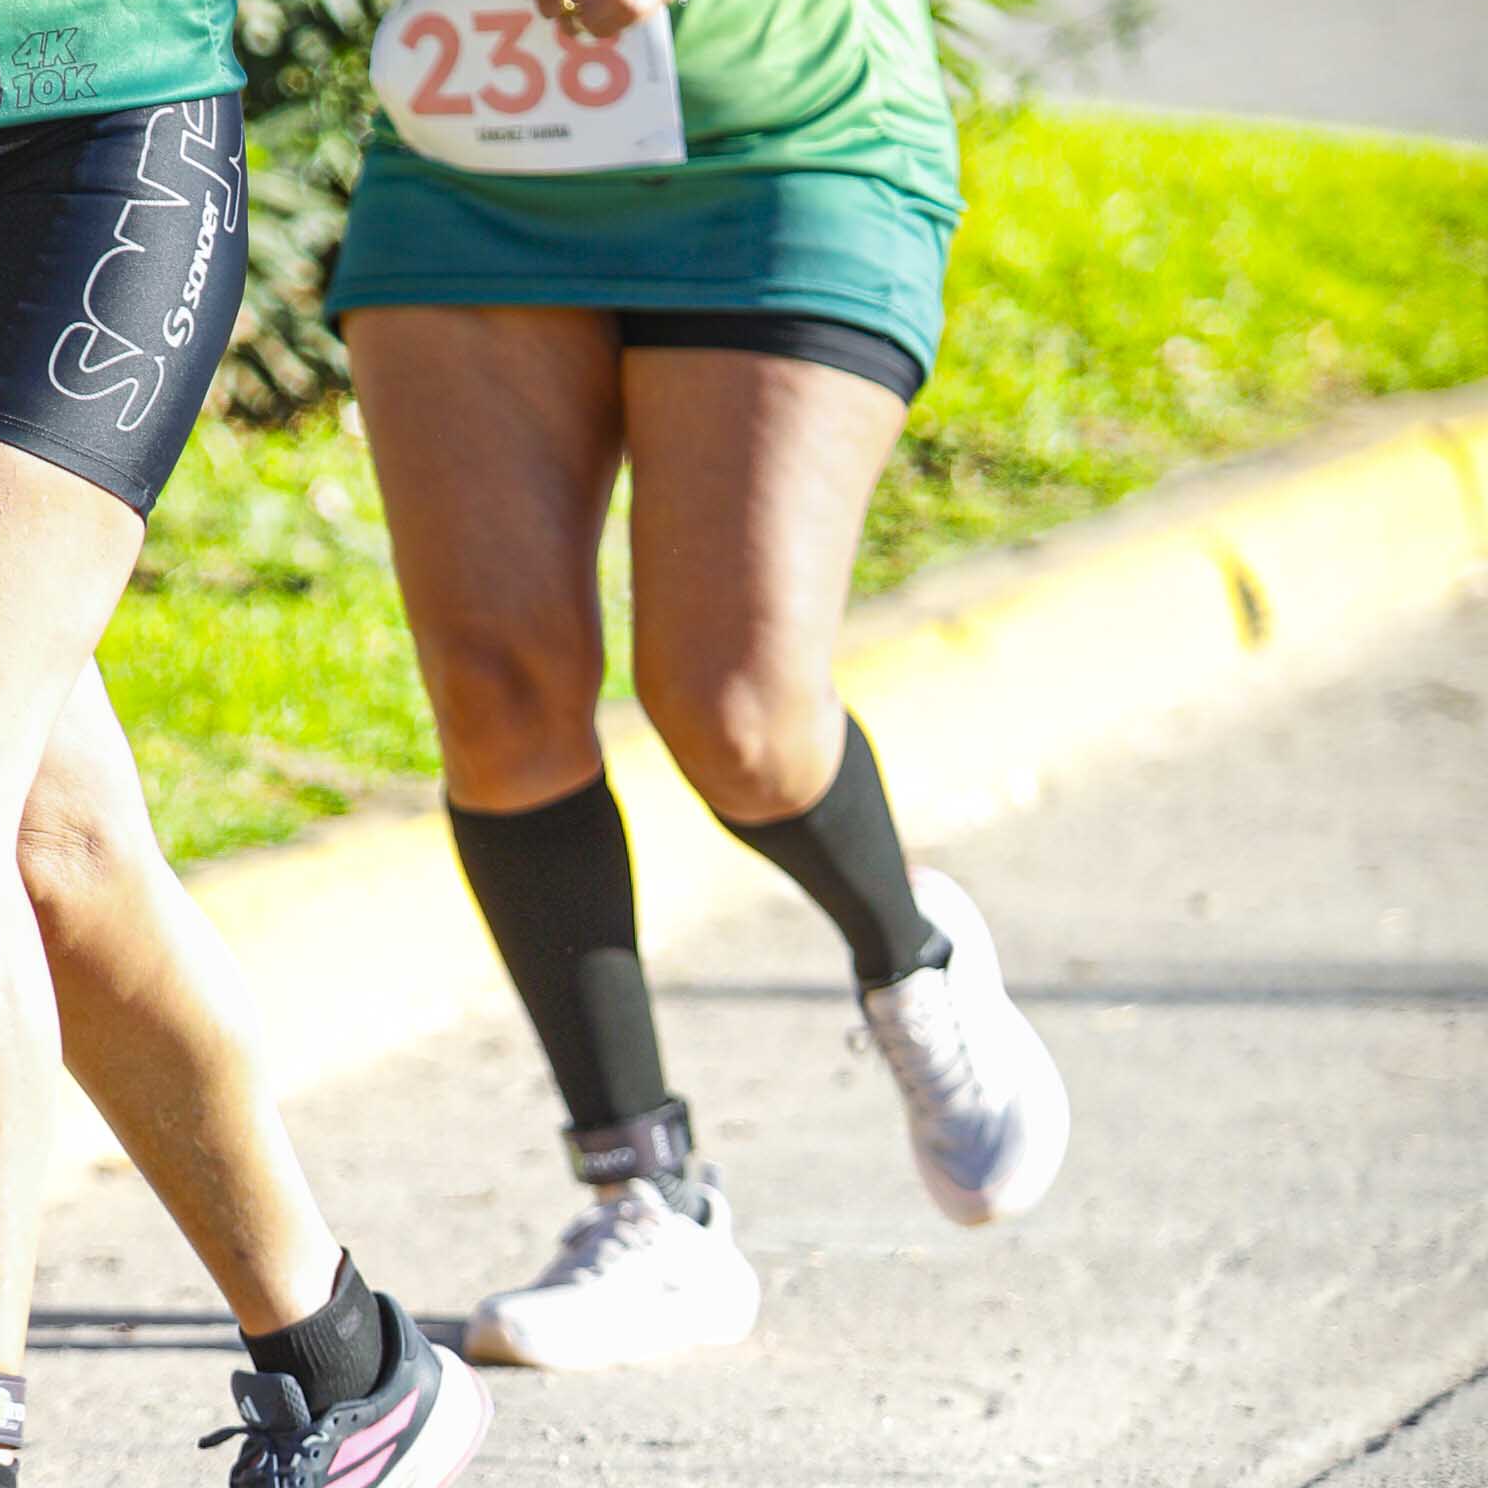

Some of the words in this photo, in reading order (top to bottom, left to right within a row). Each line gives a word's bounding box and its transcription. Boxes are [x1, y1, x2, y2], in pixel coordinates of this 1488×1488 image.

[12, 26, 78, 70] 4K
[399, 9, 632, 117] 238
[12, 63, 98, 109] 10K
